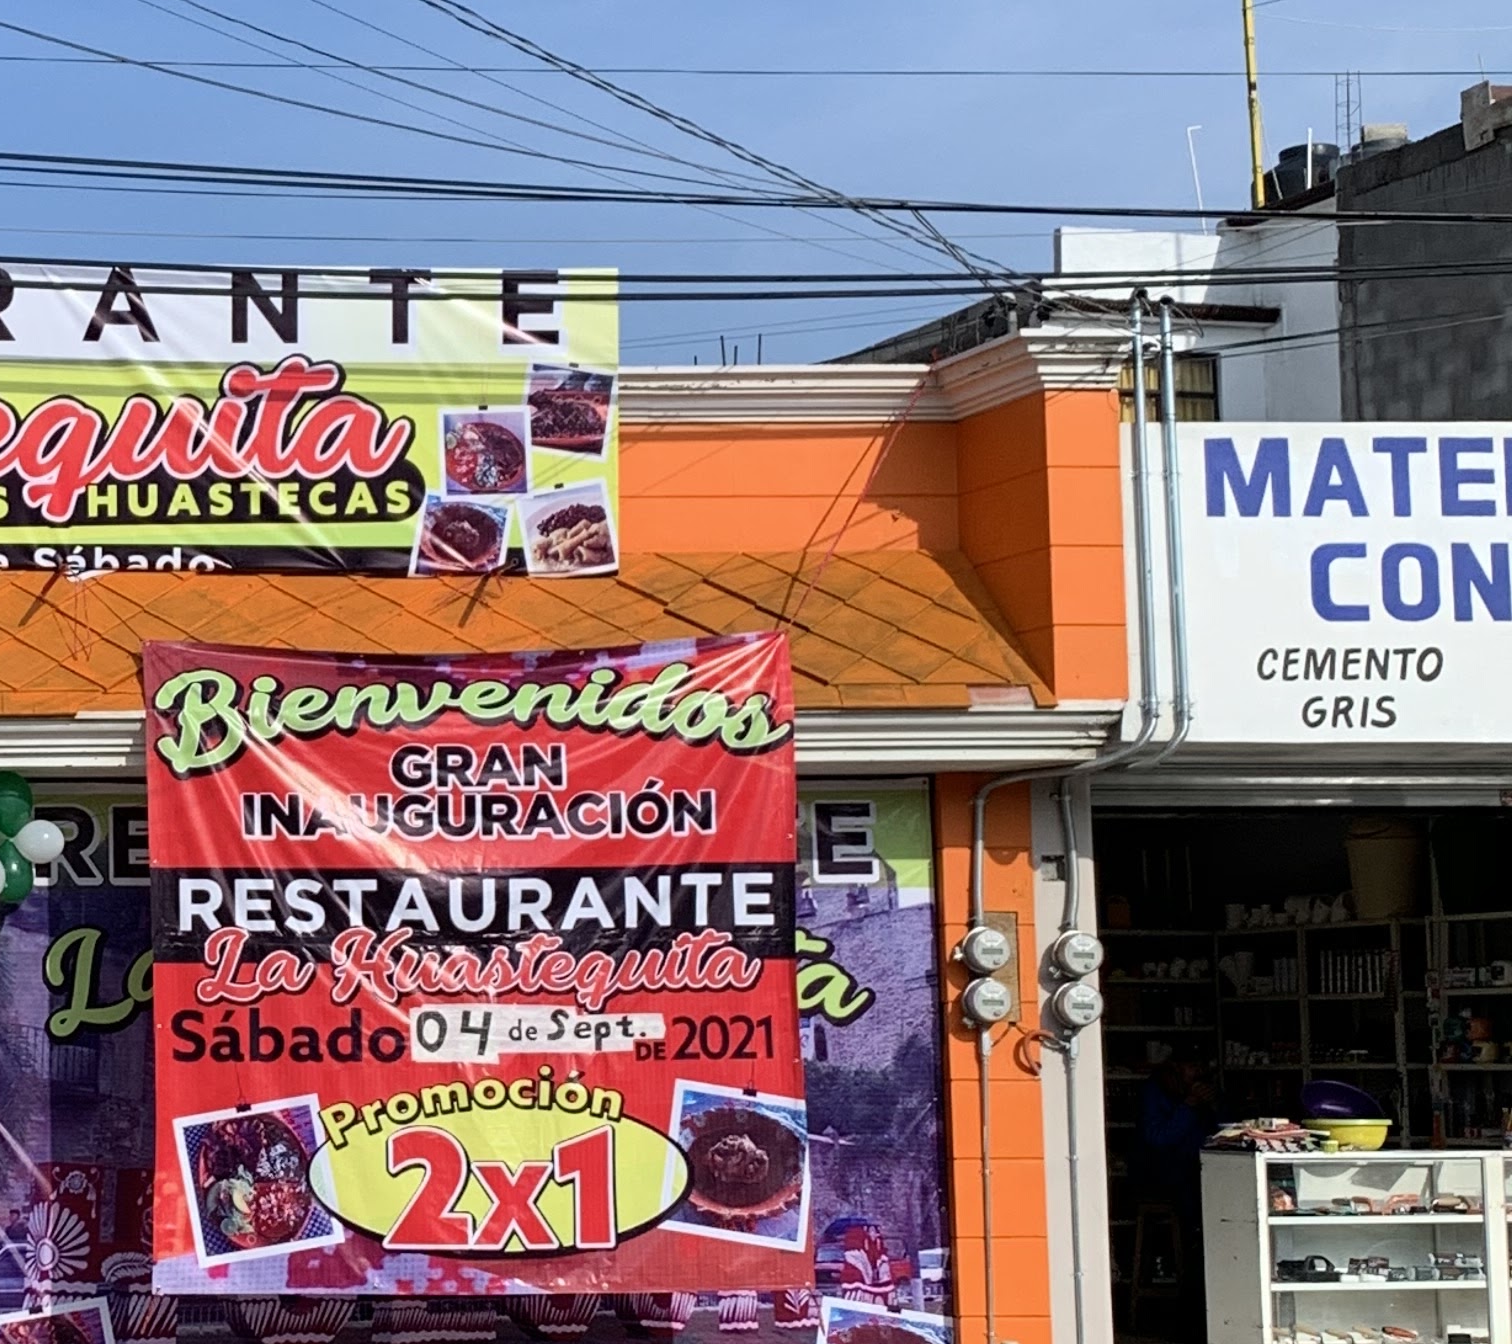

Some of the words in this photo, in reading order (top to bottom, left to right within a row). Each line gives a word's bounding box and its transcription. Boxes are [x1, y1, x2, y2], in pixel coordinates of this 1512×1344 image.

[88, 483, 411, 518] HUASTECAS
[1204, 437, 1512, 517] MATE
[1311, 542, 1512, 622] CON
[1256, 647, 1444, 682] CEMENTO
[153, 661, 793, 778] Bienvenidos
[1301, 695, 1398, 728] GRIS
[388, 744, 568, 790] GRAN
[241, 778, 718, 843] INAUGURACIÓN
[178, 873, 776, 934] RESTAURANTE
[196, 926, 316, 1004] La
[330, 928, 763, 1012] Huastequita
[171, 1008, 406, 1063] Sábado
[416, 1010, 493, 1056] 04
[508, 1018, 538, 1041] de
[547, 1009, 648, 1052] Sept.
[635, 1041, 667, 1062] DE
[672, 1015, 775, 1061] 2021
[318, 1065, 624, 1150] Promoción
[381, 1124, 619, 1252] 2x1
